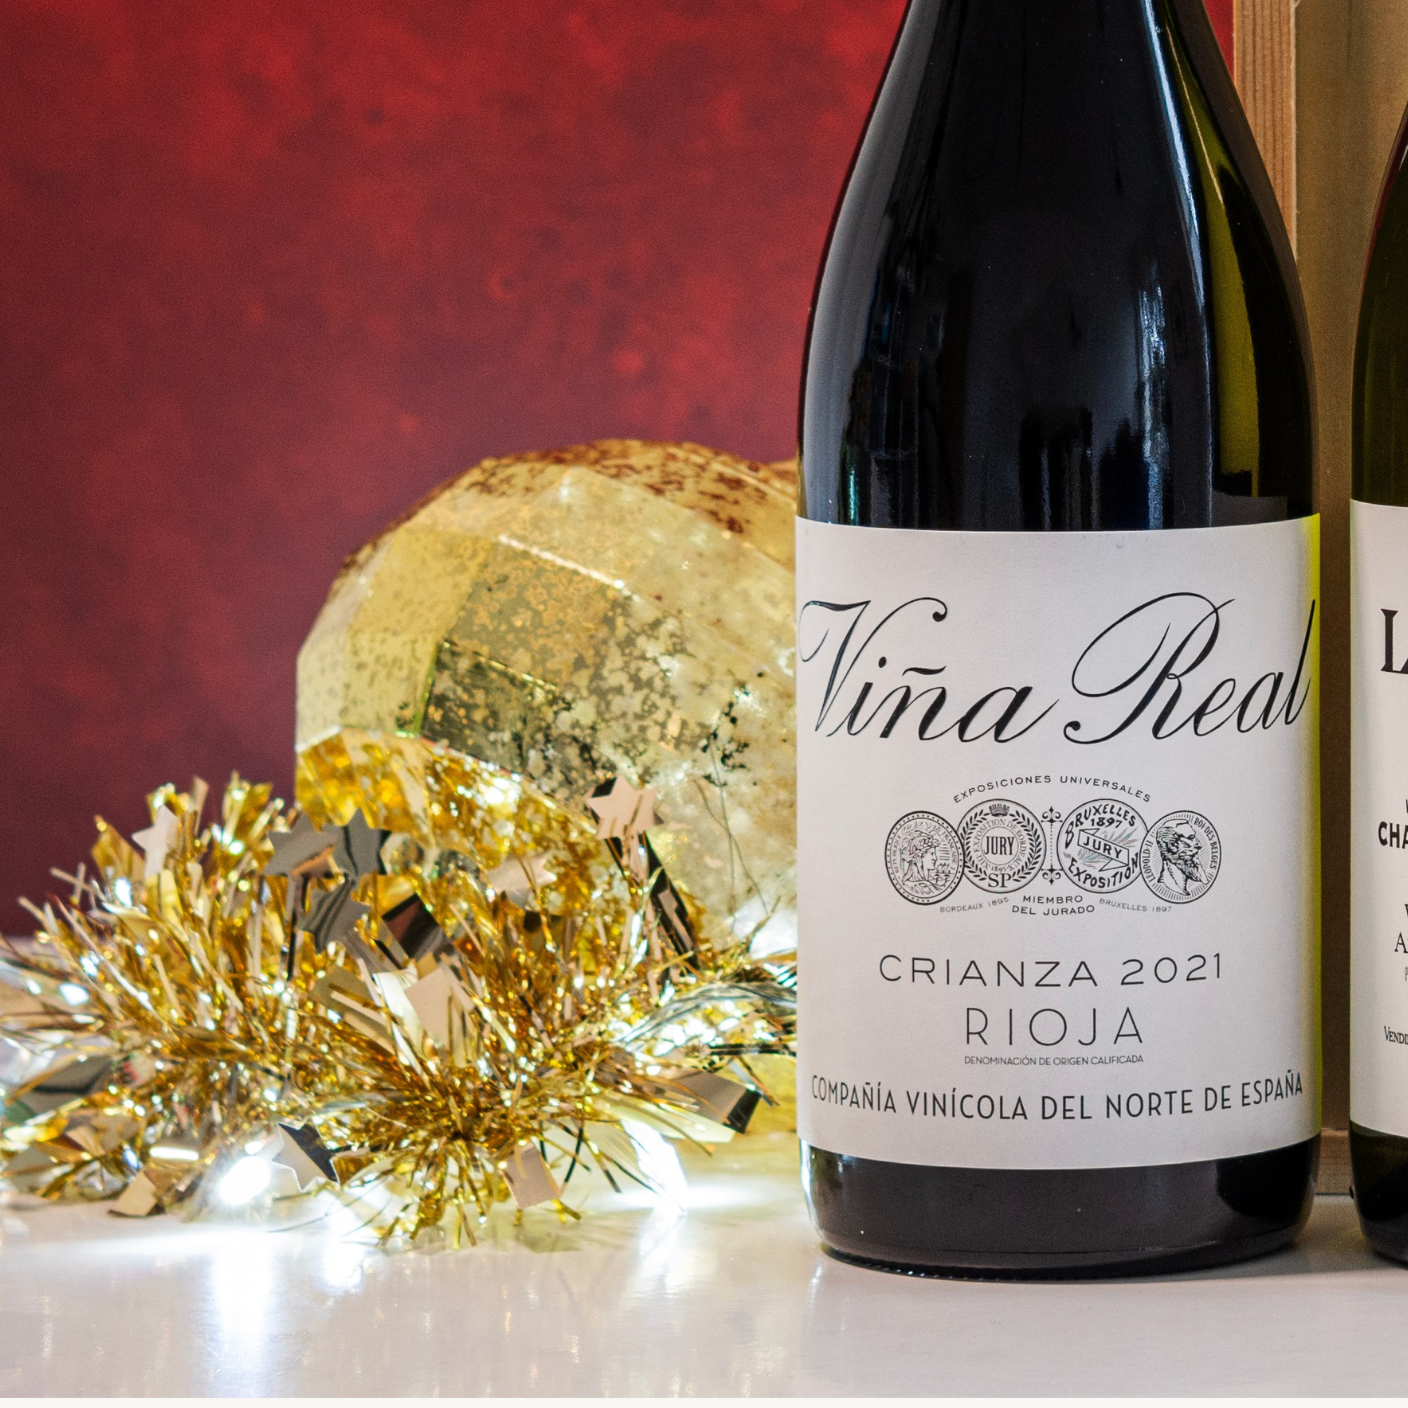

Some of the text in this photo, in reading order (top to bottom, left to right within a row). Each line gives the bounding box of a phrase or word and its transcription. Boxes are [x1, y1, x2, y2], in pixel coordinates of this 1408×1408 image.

[799, 590, 1318, 747] Viña Real
[953, 774, 1151, 804] EXPOSICIONES UNIVERSALES
[1065, 804, 1136, 849] BRUXELLES
[1091, 817, 1122, 828] 1897
[984, 836, 1015, 855] JURY
[1083, 836, 1122, 858] JURY
[1068, 852, 1138, 888] EXPOSITION
[988, 873, 1011, 888] SP
[938, 896, 1010, 914] BORDEAUX 1895
[1020, 892, 1086, 905] MIEMBRO
[1097, 896, 1174, 914] BRUXELLES 1897
[1010, 904, 1096, 917] DEL JURADO
[879, 952, 1221, 988] CRIANZA 2021
[965, 1006, 1143, 1047] RIOJA
[1038, 1056, 1051, 1066] DE
[1052, 1056, 1089, 1066] ORIGEN
[1090, 1054, 1144, 1065] CALIFICADA
[810, 1067, 1305, 1121] COMPAÑÍA VINÍCOLA DEL NORTE DE ESPAÑA
